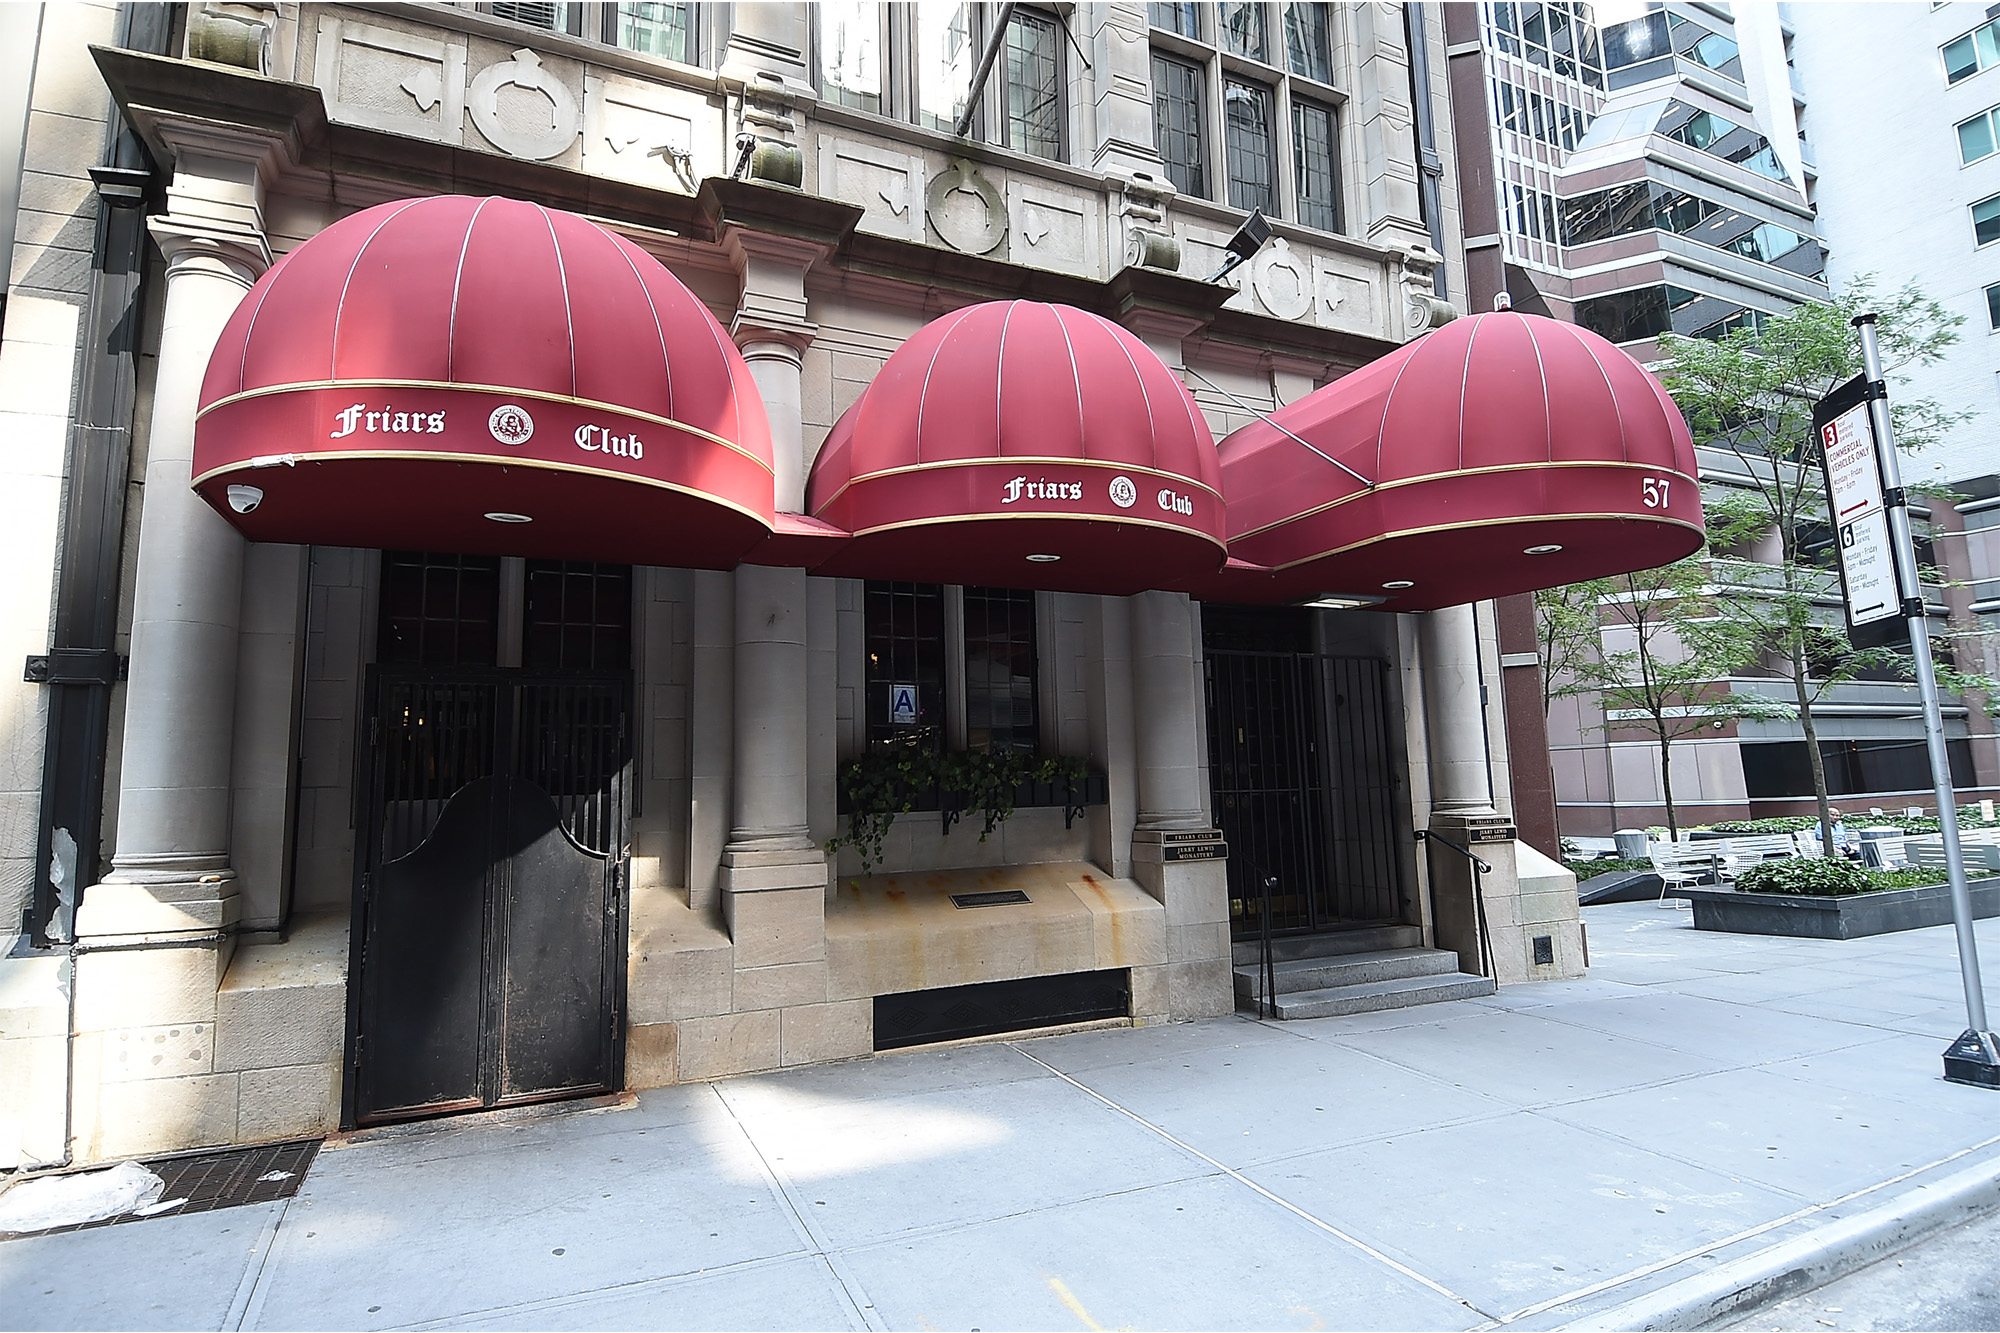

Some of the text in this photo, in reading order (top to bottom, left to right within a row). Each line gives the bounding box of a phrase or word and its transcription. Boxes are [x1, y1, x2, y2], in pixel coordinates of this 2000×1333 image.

[330, 403, 446, 439] Friars
[573, 424, 644, 460] Club
[1826, 426, 1835, 445] 3
[1830, 438, 1862, 462] COMMERCIAL
[1832, 446, 1869, 472] VEHICLES ONLY
[1834, 475, 1848, 485] Monday
[1851, 467, 1863, 477] Friday
[1001, 476, 1083, 504] Friars
[1157, 489, 1193, 516] Club
[1642, 477, 1670, 509] 57
[1844, 526, 1852, 546] 6
[1846, 552, 1861, 560] Monday
[1864, 546, 1877, 554] Friday
[1859, 555, 1875, 565] Midnight
[1849, 573, 1867, 584] Saturday
[1862, 578, 1879, 588] Midnight
[894, 690, 914, 712] A
